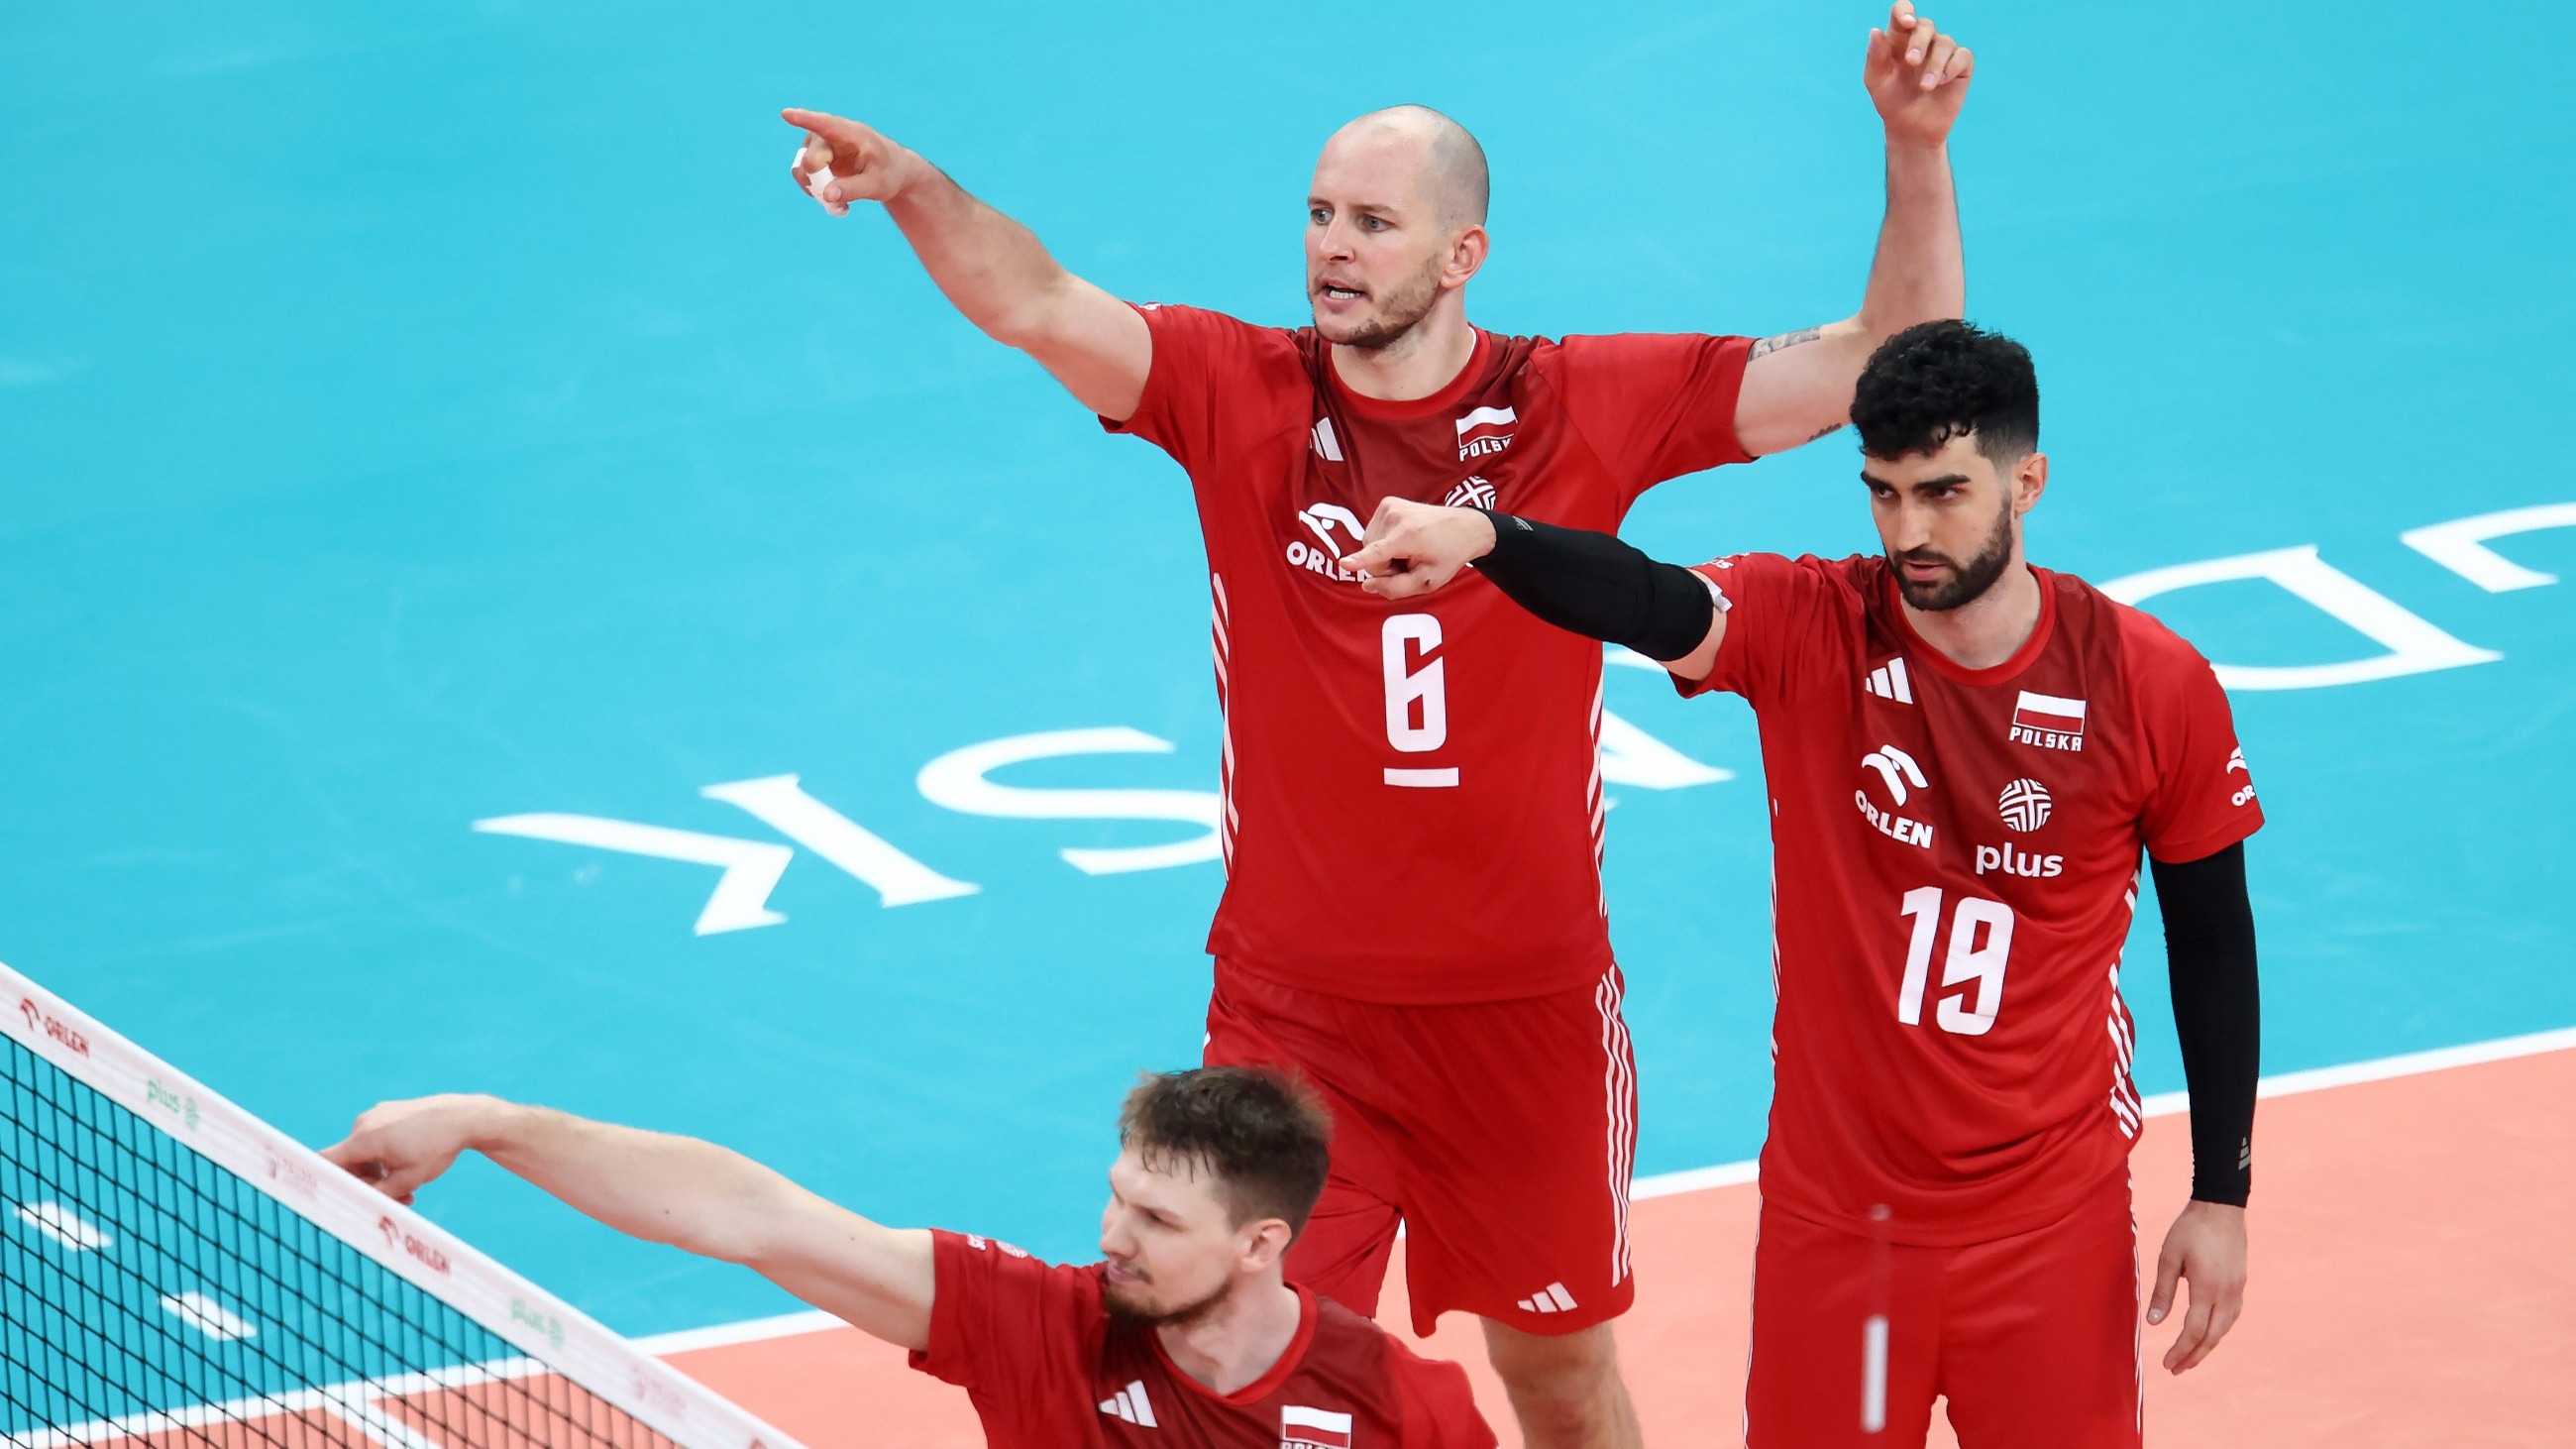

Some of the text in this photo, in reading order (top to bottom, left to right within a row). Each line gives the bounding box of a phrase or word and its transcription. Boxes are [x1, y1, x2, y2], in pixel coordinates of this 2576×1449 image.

[1459, 438, 1511, 462] POLS
[1381, 613, 1448, 753] 6
[2009, 726, 2083, 752] POLSKA
[1855, 790, 1933, 849] ORLEN
[1976, 841, 2064, 878] plus
[1898, 886, 2015, 1036] 19
